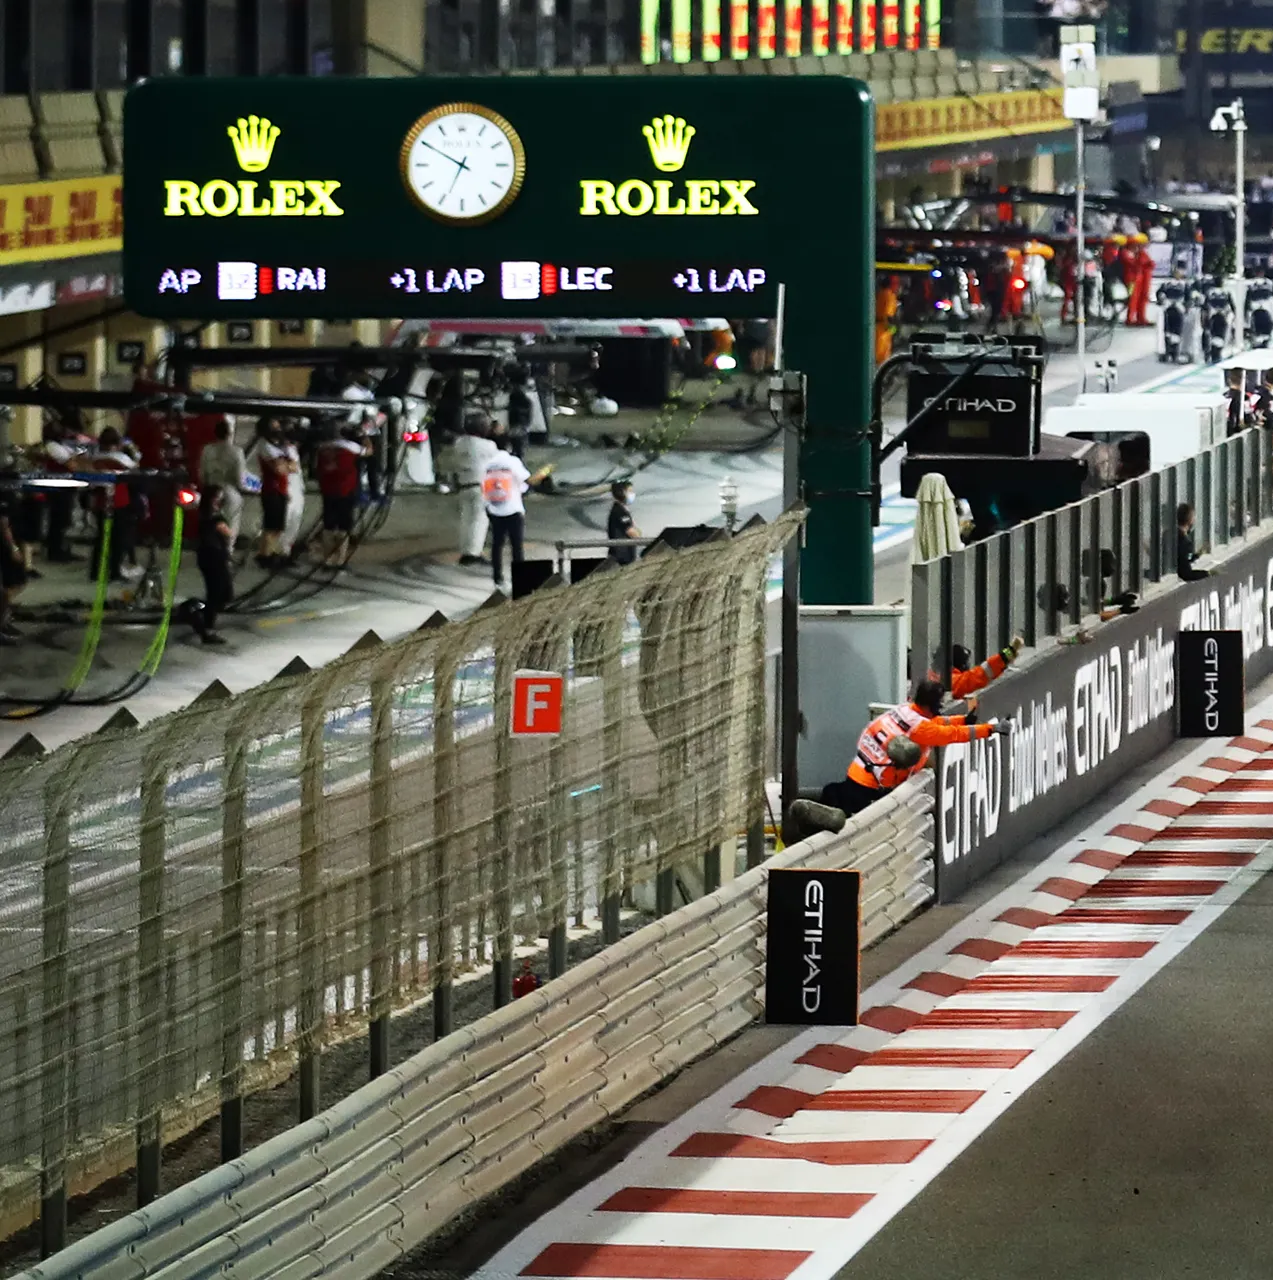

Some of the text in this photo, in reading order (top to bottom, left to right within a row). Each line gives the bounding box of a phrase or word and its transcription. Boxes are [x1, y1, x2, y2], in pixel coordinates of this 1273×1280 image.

[163, 180, 344, 217] ROLEX
[579, 179, 759, 216] ROLEX
[277, 267, 326, 291] RAI
[426, 268, 485, 293] LAP
[560, 266, 613, 291] LEC
[708, 268, 766, 292] LAP
[526, 684, 552, 727] F
[1073, 645, 1123, 776] ETIHAD
[1204, 637, 1219, 731] ETIHAD
[941, 716, 1002, 865] ETIHAD
[802, 879, 825, 1014] ETIHAD
